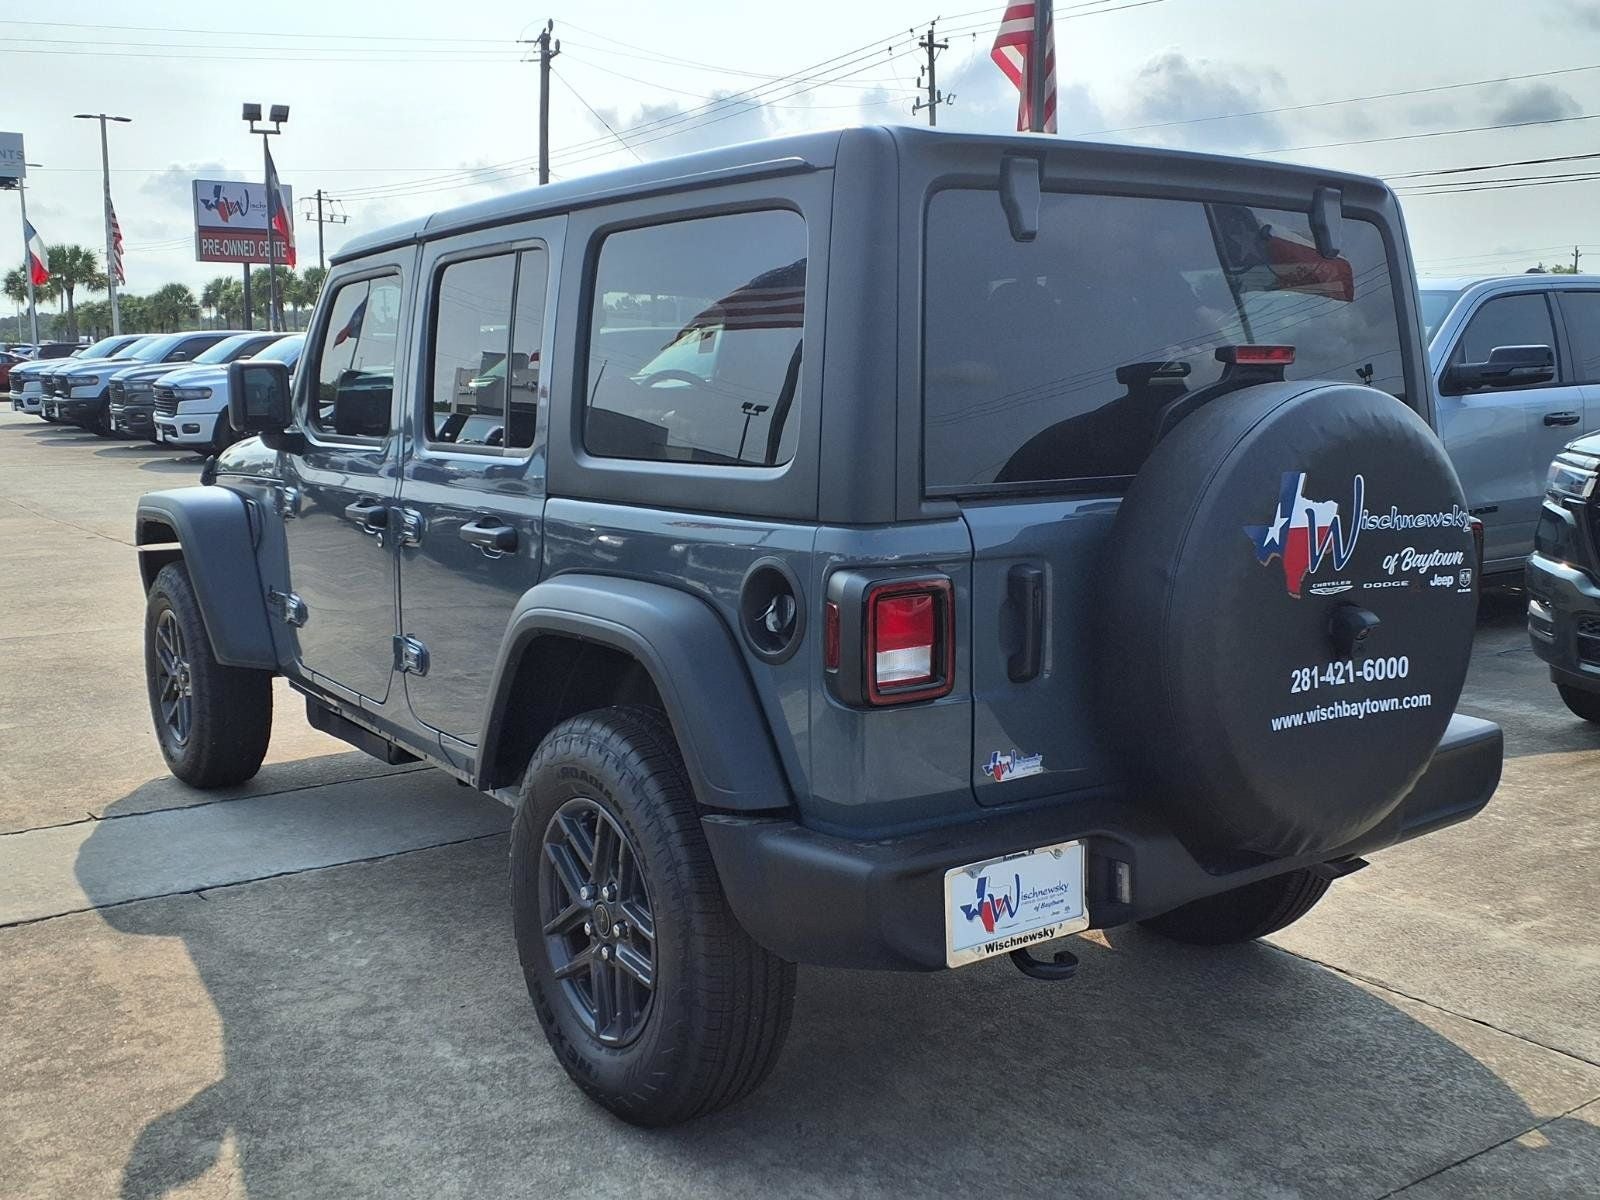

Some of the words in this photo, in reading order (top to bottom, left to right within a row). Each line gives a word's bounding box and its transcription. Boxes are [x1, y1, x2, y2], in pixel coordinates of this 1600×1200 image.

[202, 239, 255, 257] PRE-OWNED
[258, 241, 287, 258] CETE
[1305, 474, 1470, 574] Wischnewsky
[1382, 551, 1398, 575] of
[1401, 546, 1464, 574] Baytown
[1363, 580, 1409, 589] DODGE
[1429, 573, 1454, 588] Jeep
[1290, 655, 1409, 694] 281-421-6000
[1271, 693, 1432, 732] www.wischbaytown.com
[987, 874, 1069, 922] Wischnewsky
[985, 927, 1056, 954] Wischnewsky
